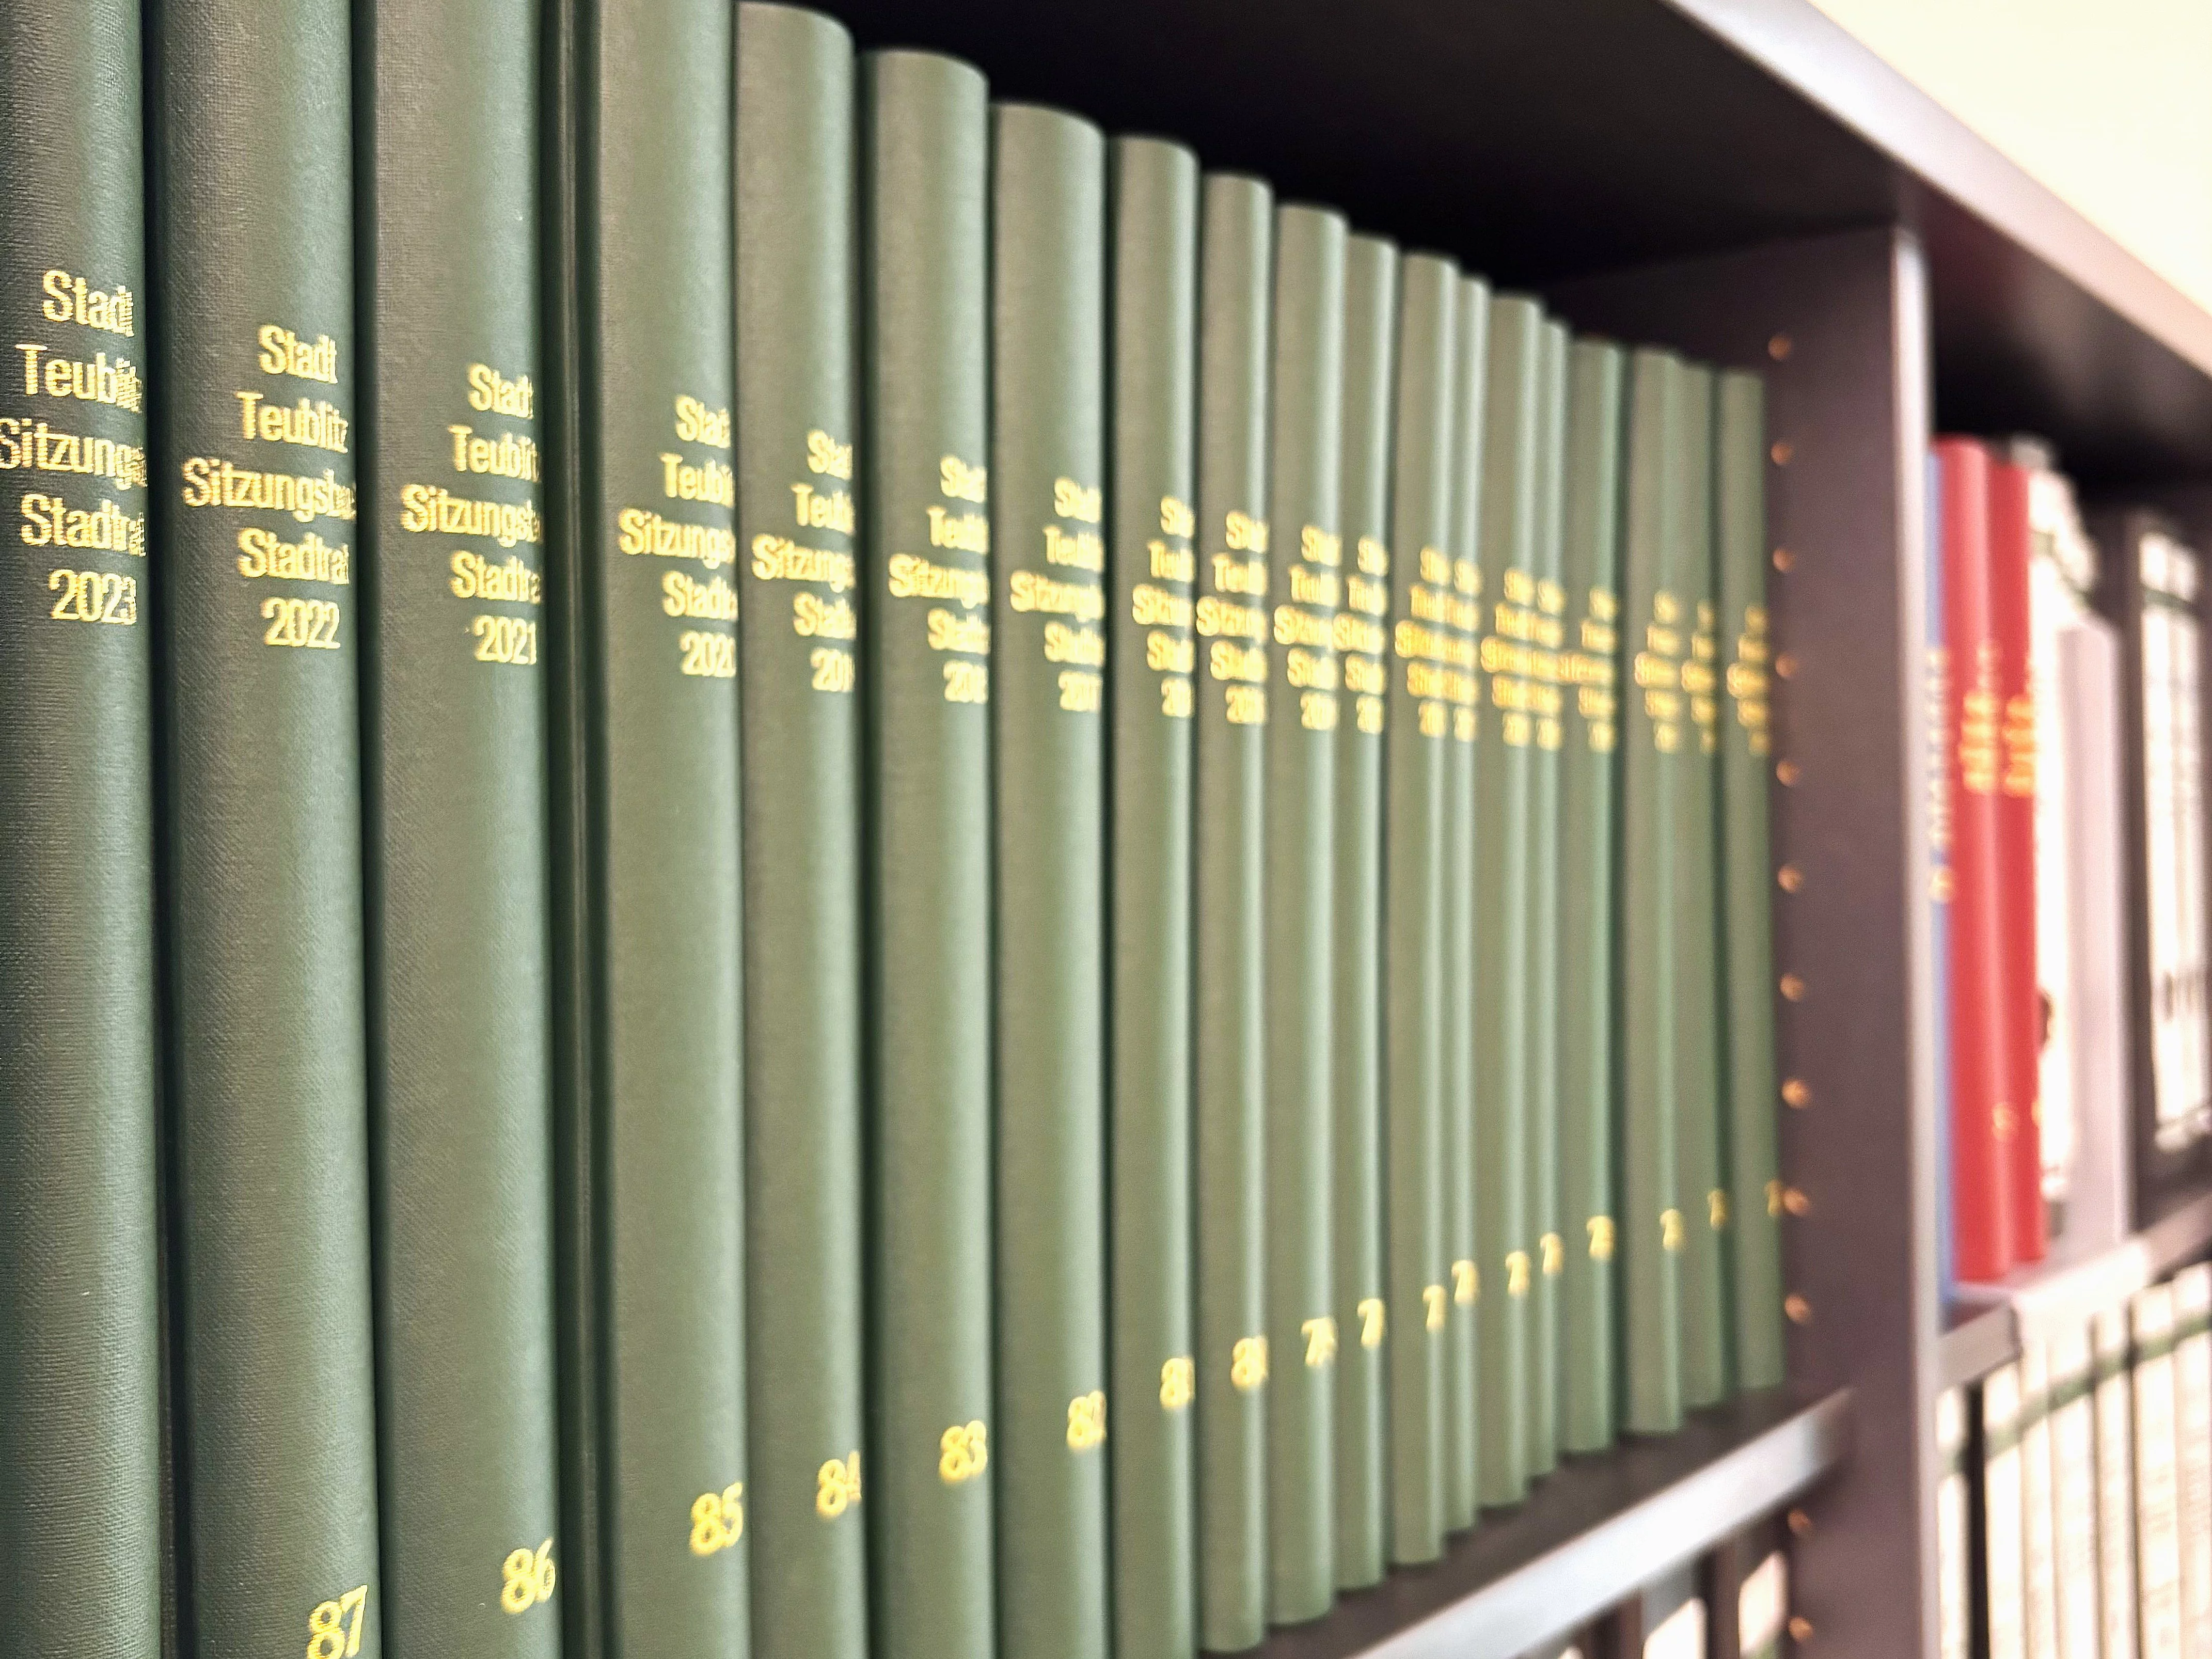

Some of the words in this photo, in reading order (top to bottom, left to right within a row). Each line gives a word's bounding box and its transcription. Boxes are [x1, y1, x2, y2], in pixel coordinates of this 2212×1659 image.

[259, 325, 338, 384] Stadt
[235, 391, 348, 453] Teublitz
[49, 569, 137, 625] 2023
[450, 550, 541, 604] Stadtra
[262, 597, 340, 649] 2022
[474, 616, 536, 665] 2021
[939, 1420, 987, 1484] 83
[690, 1482, 744, 1556] 85
[501, 1539, 556, 1614] 86
[306, 1585, 368, 1659] 87
